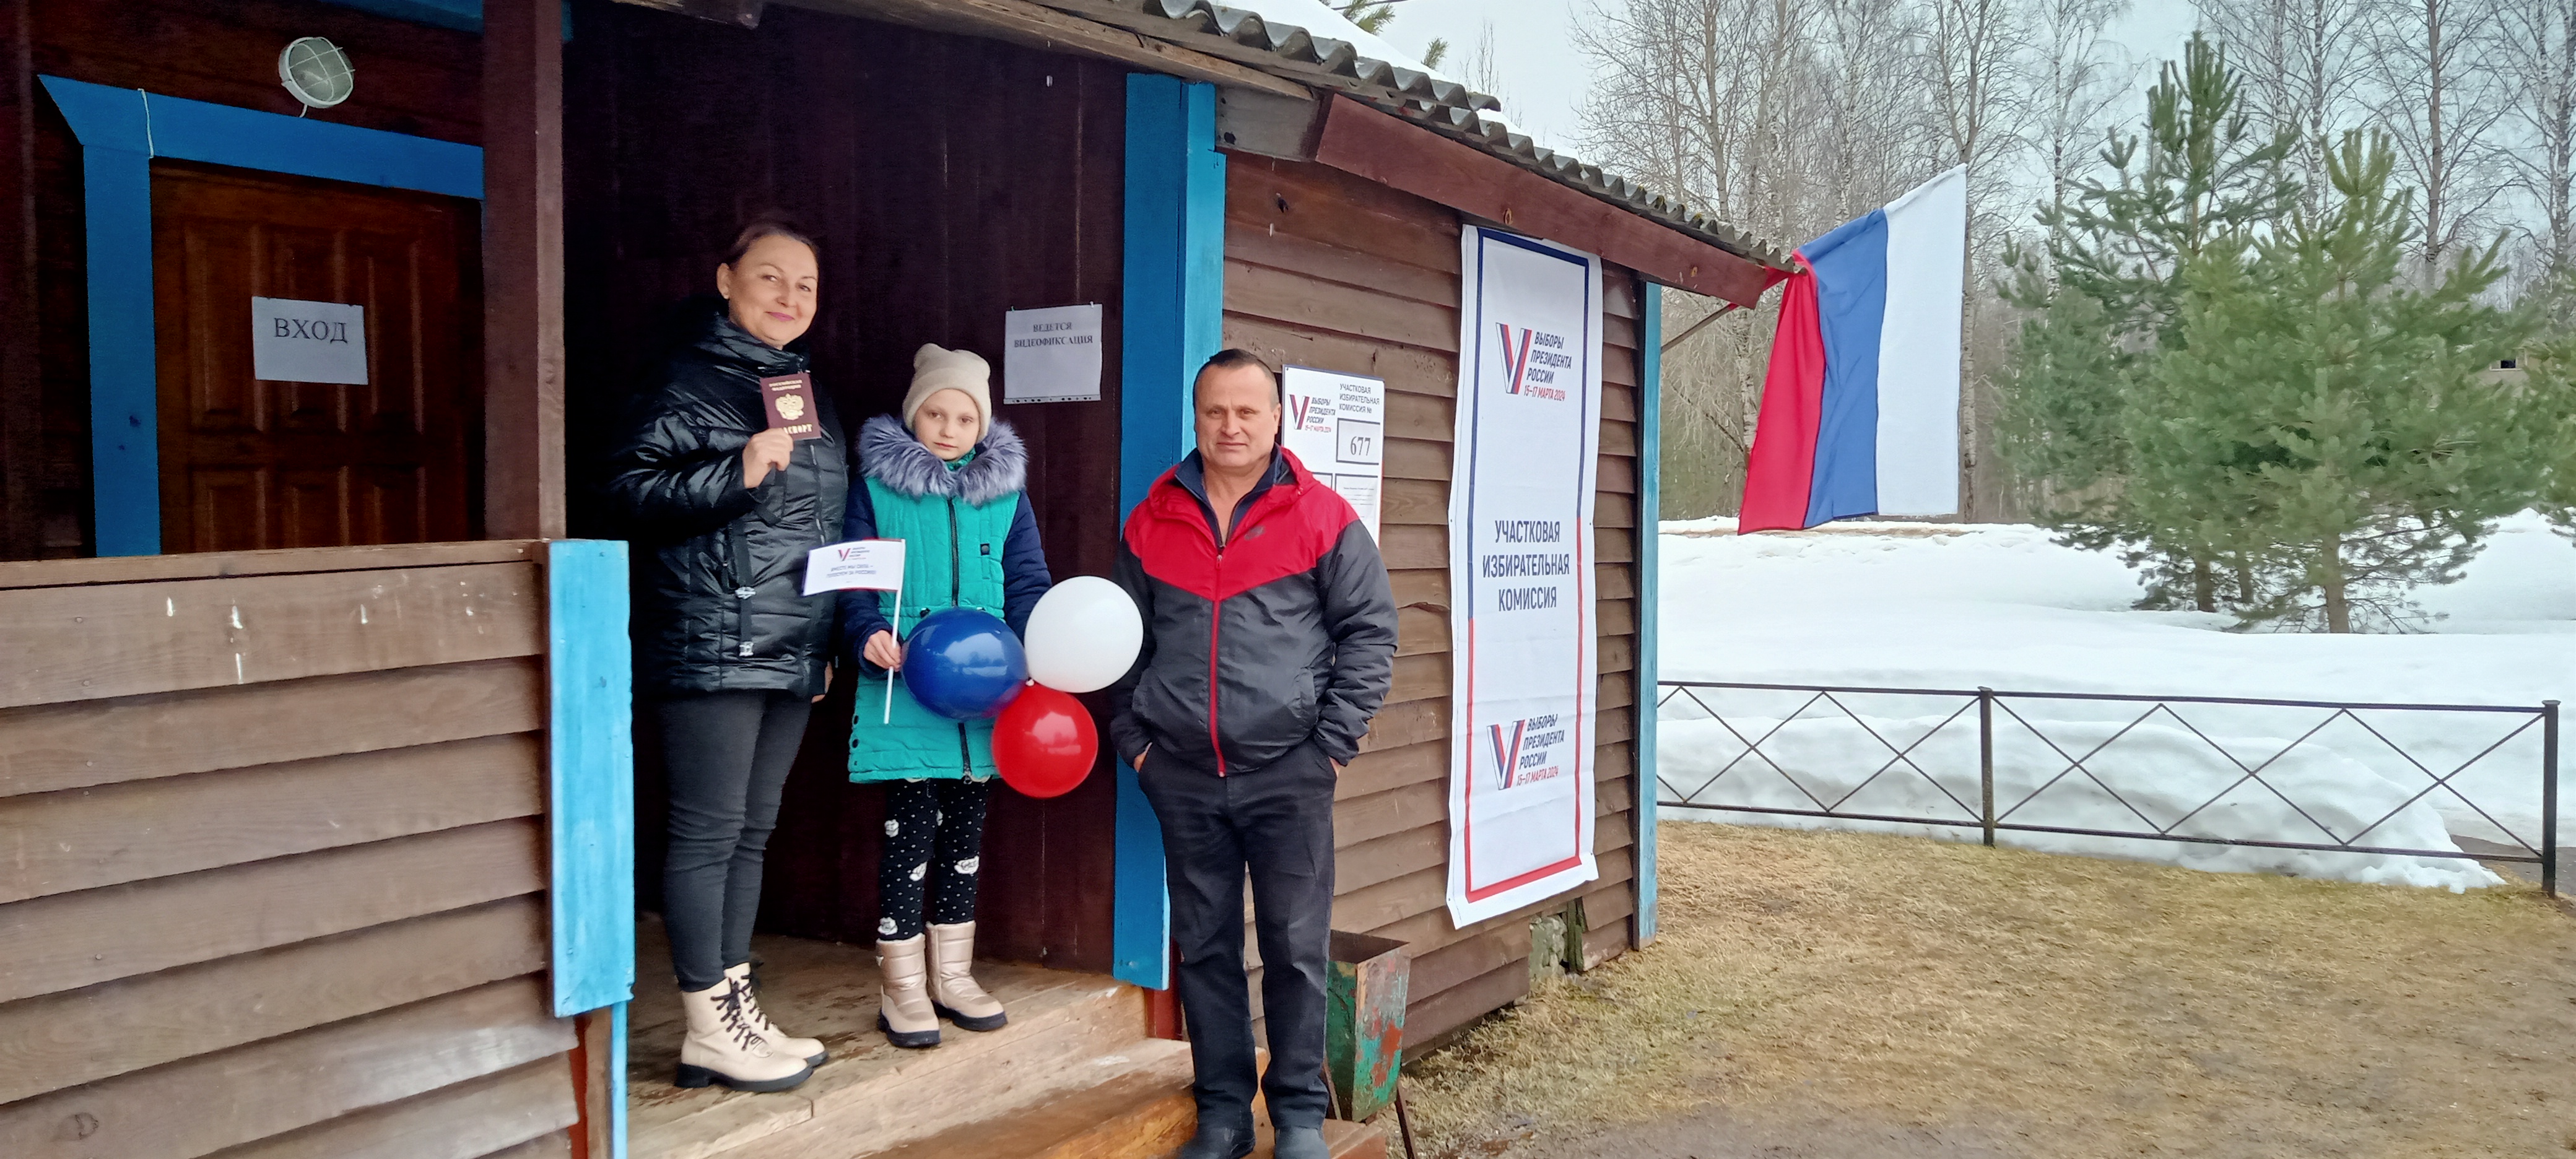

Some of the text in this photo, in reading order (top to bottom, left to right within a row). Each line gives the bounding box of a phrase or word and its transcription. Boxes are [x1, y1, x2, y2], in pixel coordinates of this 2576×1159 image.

[274, 318, 348, 344] ВХОД
[1033, 322, 1073, 332] ВЕДЕТСЯ
[1014, 336, 1093, 347] ВИДЕОФИКСАЦИЯ
[1534, 331, 1564, 349] ВЫБОРЫ
[1530, 349, 1572, 369] ПРЕЗИДЕНТА
[1526, 367, 1555, 384] РОССИИ
[1340, 383, 1371, 394] УЧАСТКОВАЯ
[1538, 387, 1554, 399] МАРТА
[1554, 389, 1566, 401] 2024
[1311, 397, 1331, 406] ВЫБОРЫ
[1339, 393, 1380, 405] ИЗБИРАТЕЛЬНАЯ
[1308, 406, 1336, 415] ПРЕЗИДЕНТА
[1339, 403, 1366, 413] КОМИССИЯ
[783, 423, 812, 434] СПОРТ
[1350, 436, 1371, 456] 677
[1495, 520, 1560, 543] УЧАСТКОВАЯ
[1482, 553, 1569, 578] ИЗБИРАТЕЛЬНАЯ
[1499, 586, 1557, 611] КОМИССИЯ
[1527, 714, 1558, 732] ВЫБОРЫ
[1523, 729, 1565, 751] ПРЕЗИДЕНТА
[1519, 751, 1547, 770] РОССИИ
[1530, 768, 1547, 783] МАРТА
